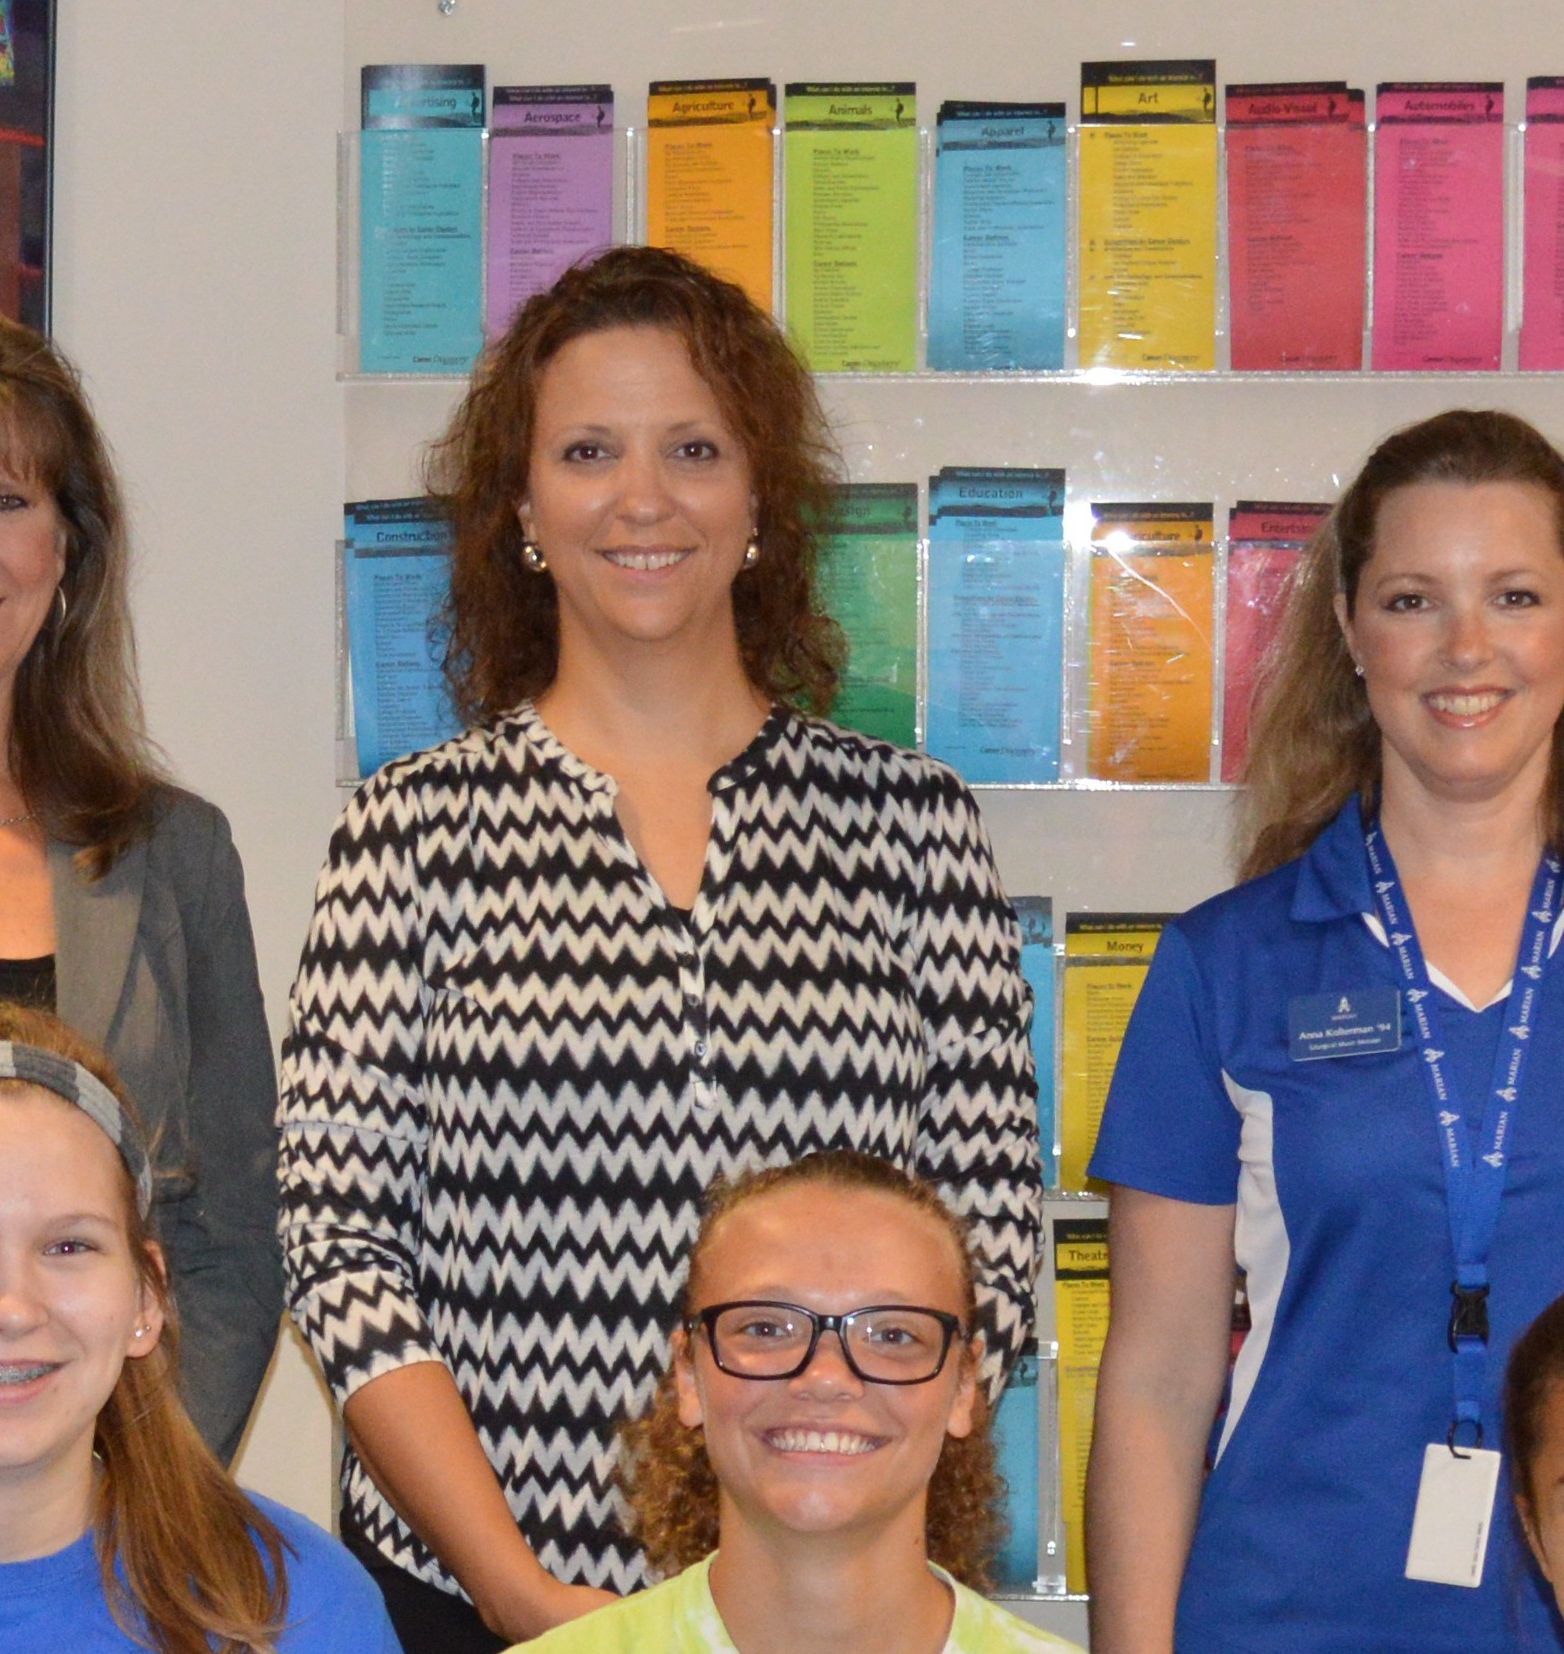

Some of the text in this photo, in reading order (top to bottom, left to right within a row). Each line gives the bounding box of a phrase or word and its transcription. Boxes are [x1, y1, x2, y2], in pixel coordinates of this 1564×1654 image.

[672, 100, 735, 114] Agriculture
[829, 103, 873, 115] Animals
[1138, 92, 1159, 104] Art
[524, 111, 582, 123] Aerospace
[980, 125, 1025, 137] Apparel
[959, 487, 1024, 499] Education
[1381, 893, 1399, 926] MARIAN
[1106, 941, 1144, 953] Money
[1398, 945, 1415, 980] MARIAN
[1521, 987, 1535, 1024] MARIAN
[1414, 1003, 1432, 1040] MARIAN
[1299, 1031, 1324, 1040] Anna
[1507, 1048, 1523, 1086] MARIAN
[1431, 1063, 1448, 1101] MARIAN
[1494, 1110, 1509, 1151] MARIAN
[1445, 1127, 1460, 1168] MARIAN
